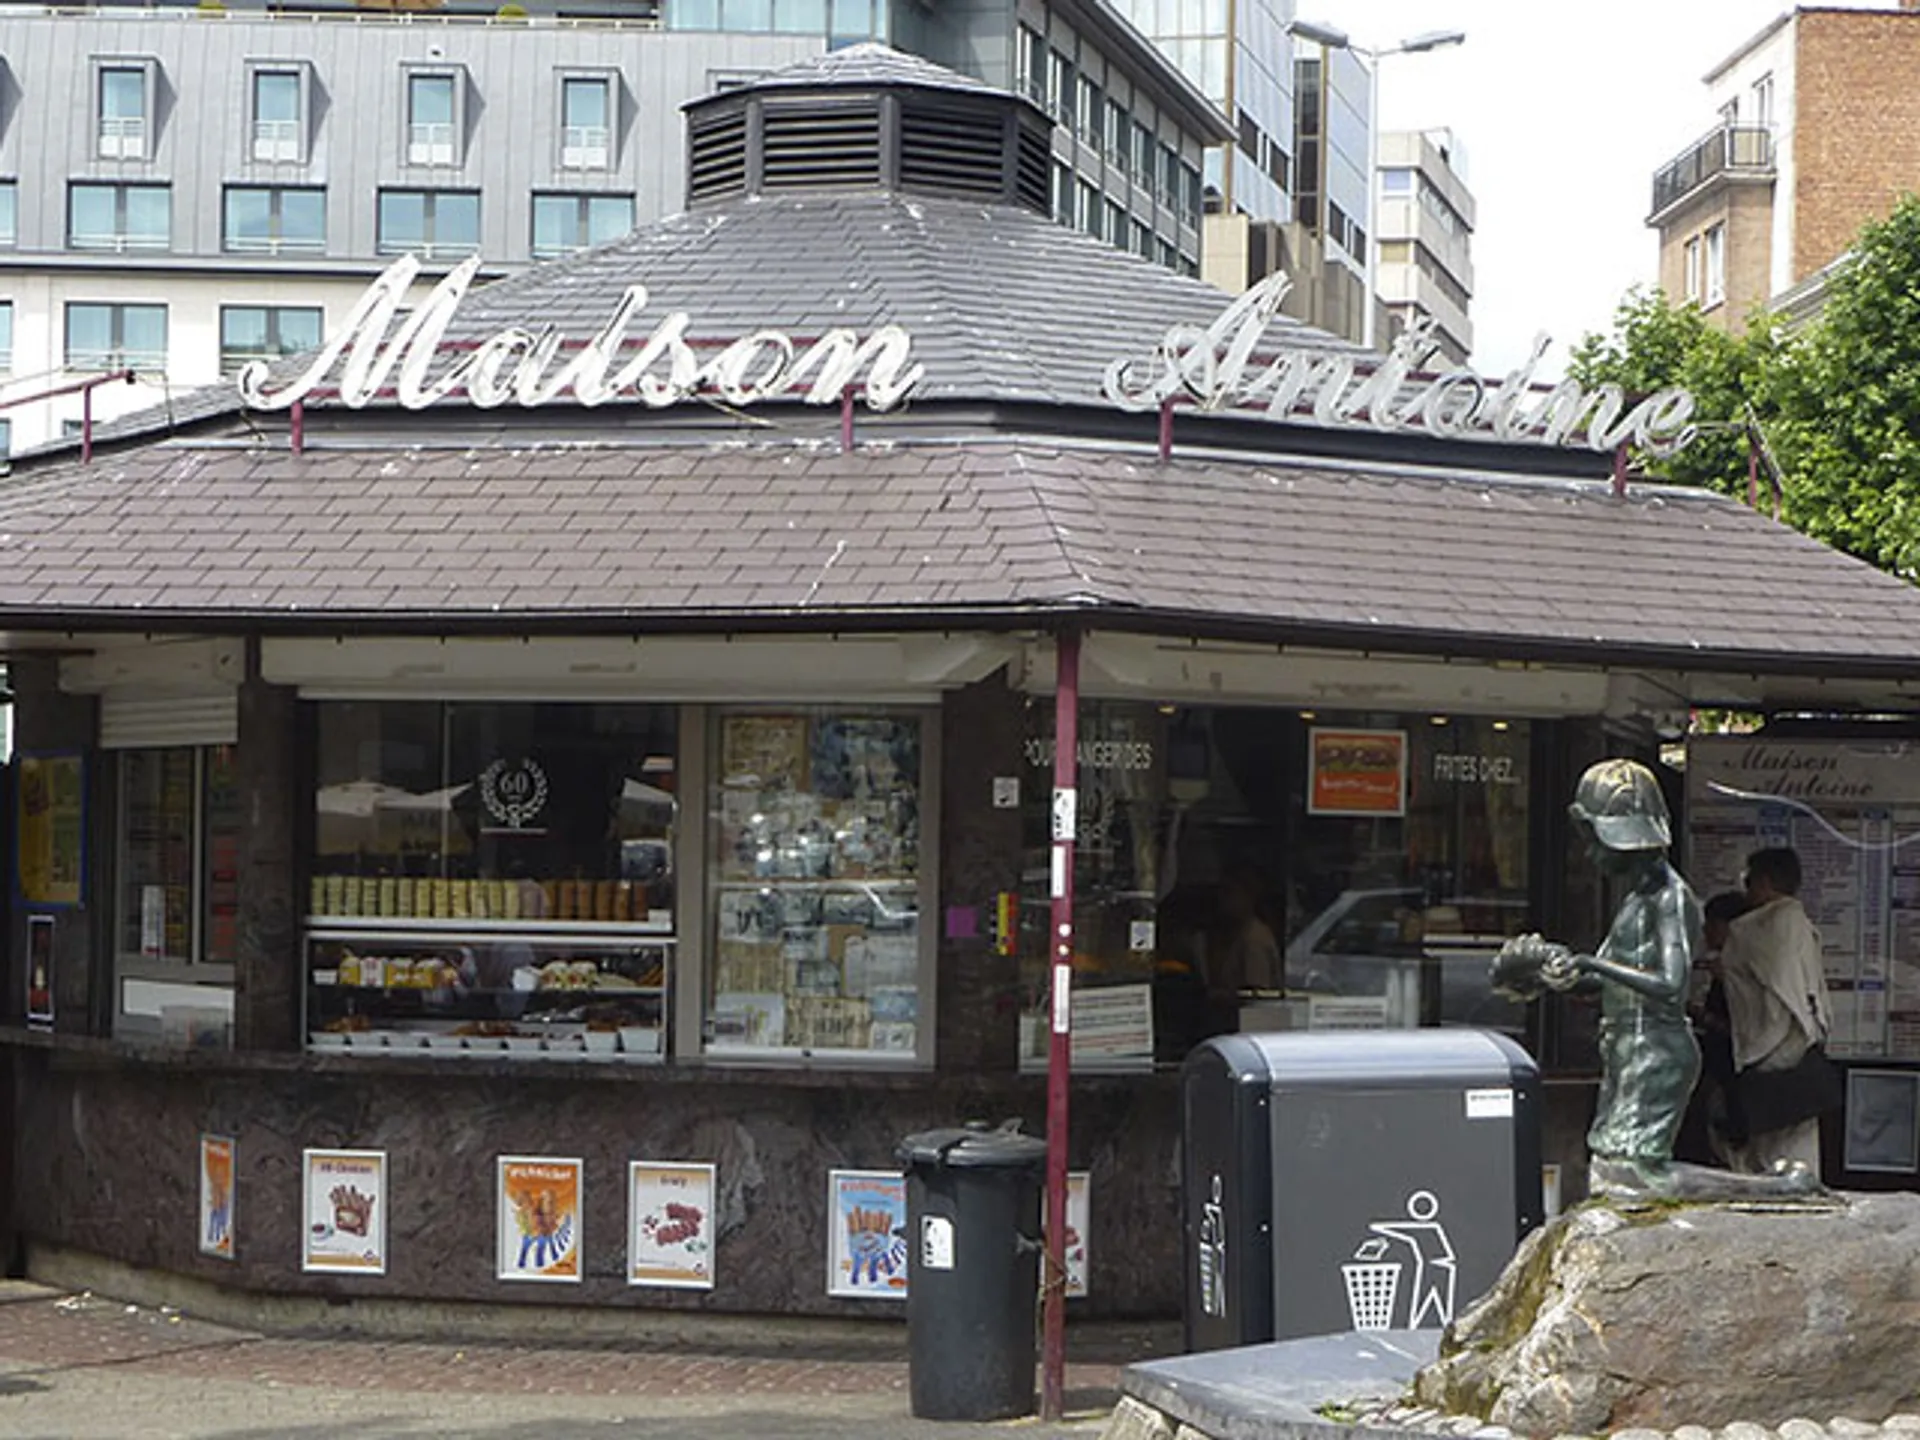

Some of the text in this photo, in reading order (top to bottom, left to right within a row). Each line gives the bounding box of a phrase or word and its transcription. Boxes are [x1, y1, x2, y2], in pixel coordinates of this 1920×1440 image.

[238, 252, 1699, 458] Maison Antoine
[1124, 742, 1152, 769] DES
[1434, 754, 1477, 782] FRITES
[1722, 744, 1839, 771] Maison
[500, 771, 529, 793] 60
[1752, 771, 1874, 797] Antoine
